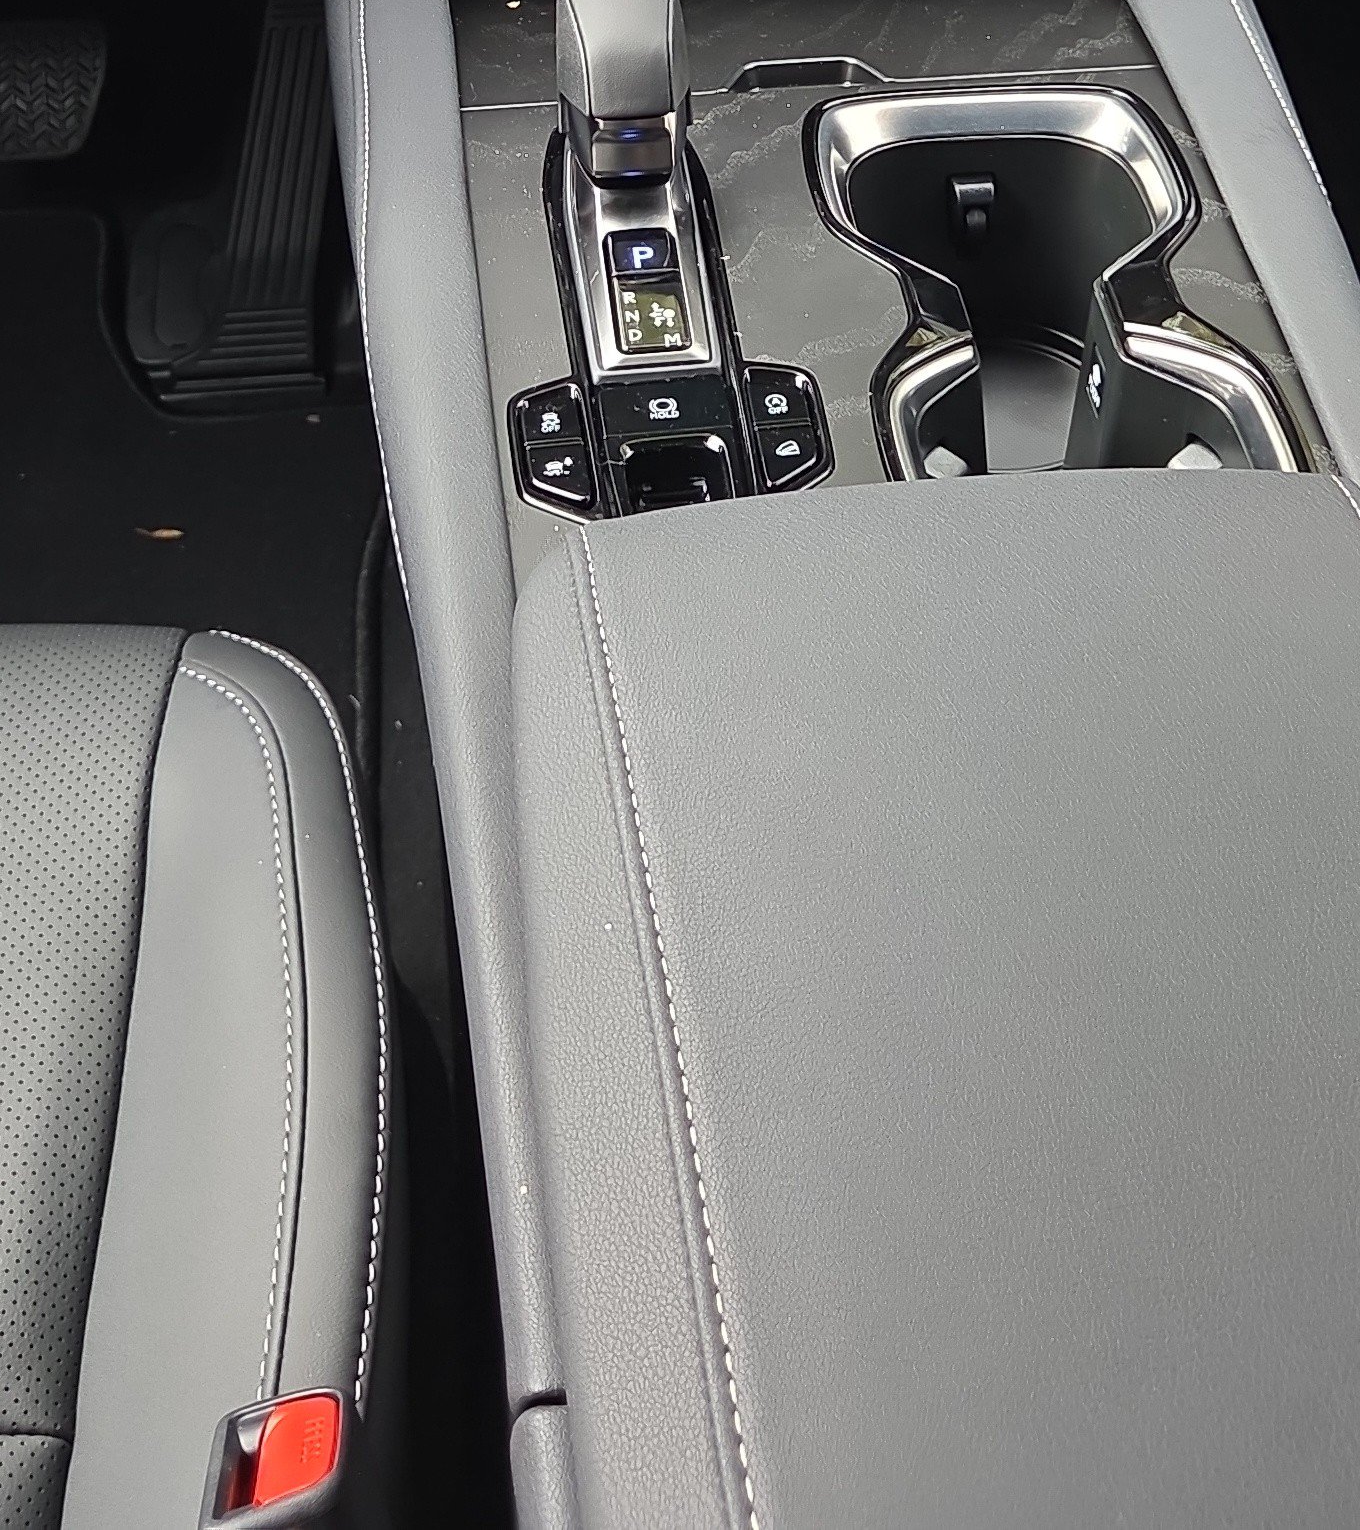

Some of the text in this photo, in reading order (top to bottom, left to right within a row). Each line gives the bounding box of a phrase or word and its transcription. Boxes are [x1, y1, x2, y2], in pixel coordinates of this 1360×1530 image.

[631, 246, 654, 268] P
[623, 291, 637, 305] R
[624, 309, 640, 323] N
[627, 329, 642, 343] D
[663, 332, 682, 348] M
[650, 411, 680, 420] HOLD
[767, 405, 788, 415] OFF
[540, 424, 561, 433] OFF
